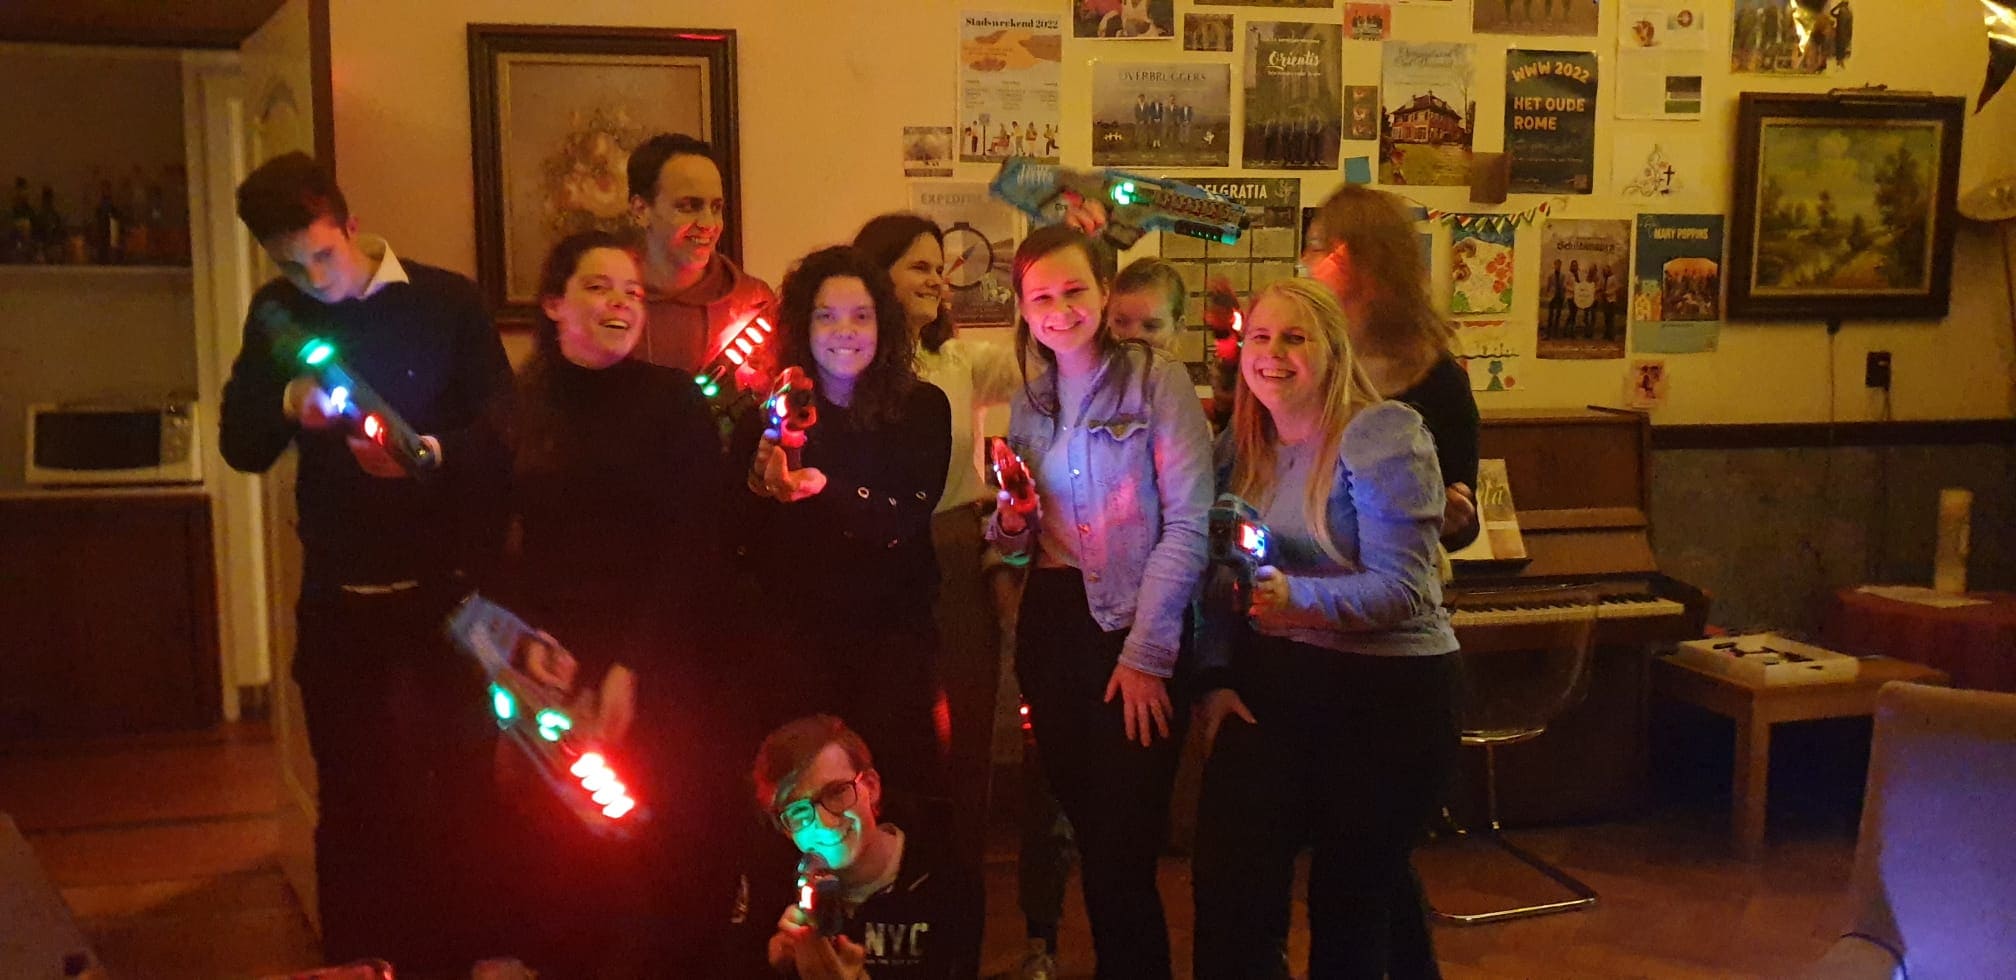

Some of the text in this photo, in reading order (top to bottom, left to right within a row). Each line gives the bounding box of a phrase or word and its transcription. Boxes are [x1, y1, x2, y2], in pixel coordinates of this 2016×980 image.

[1035, 18, 1059, 30] 2022
[1512, 61, 1590, 84] WWW 2022
[1514, 96, 1586, 112] HET OUDE
[1514, 115, 1558, 131] ROME
[1653, 227, 1709, 240] MARY POPPINS
[866, 922, 928, 956] NYC
